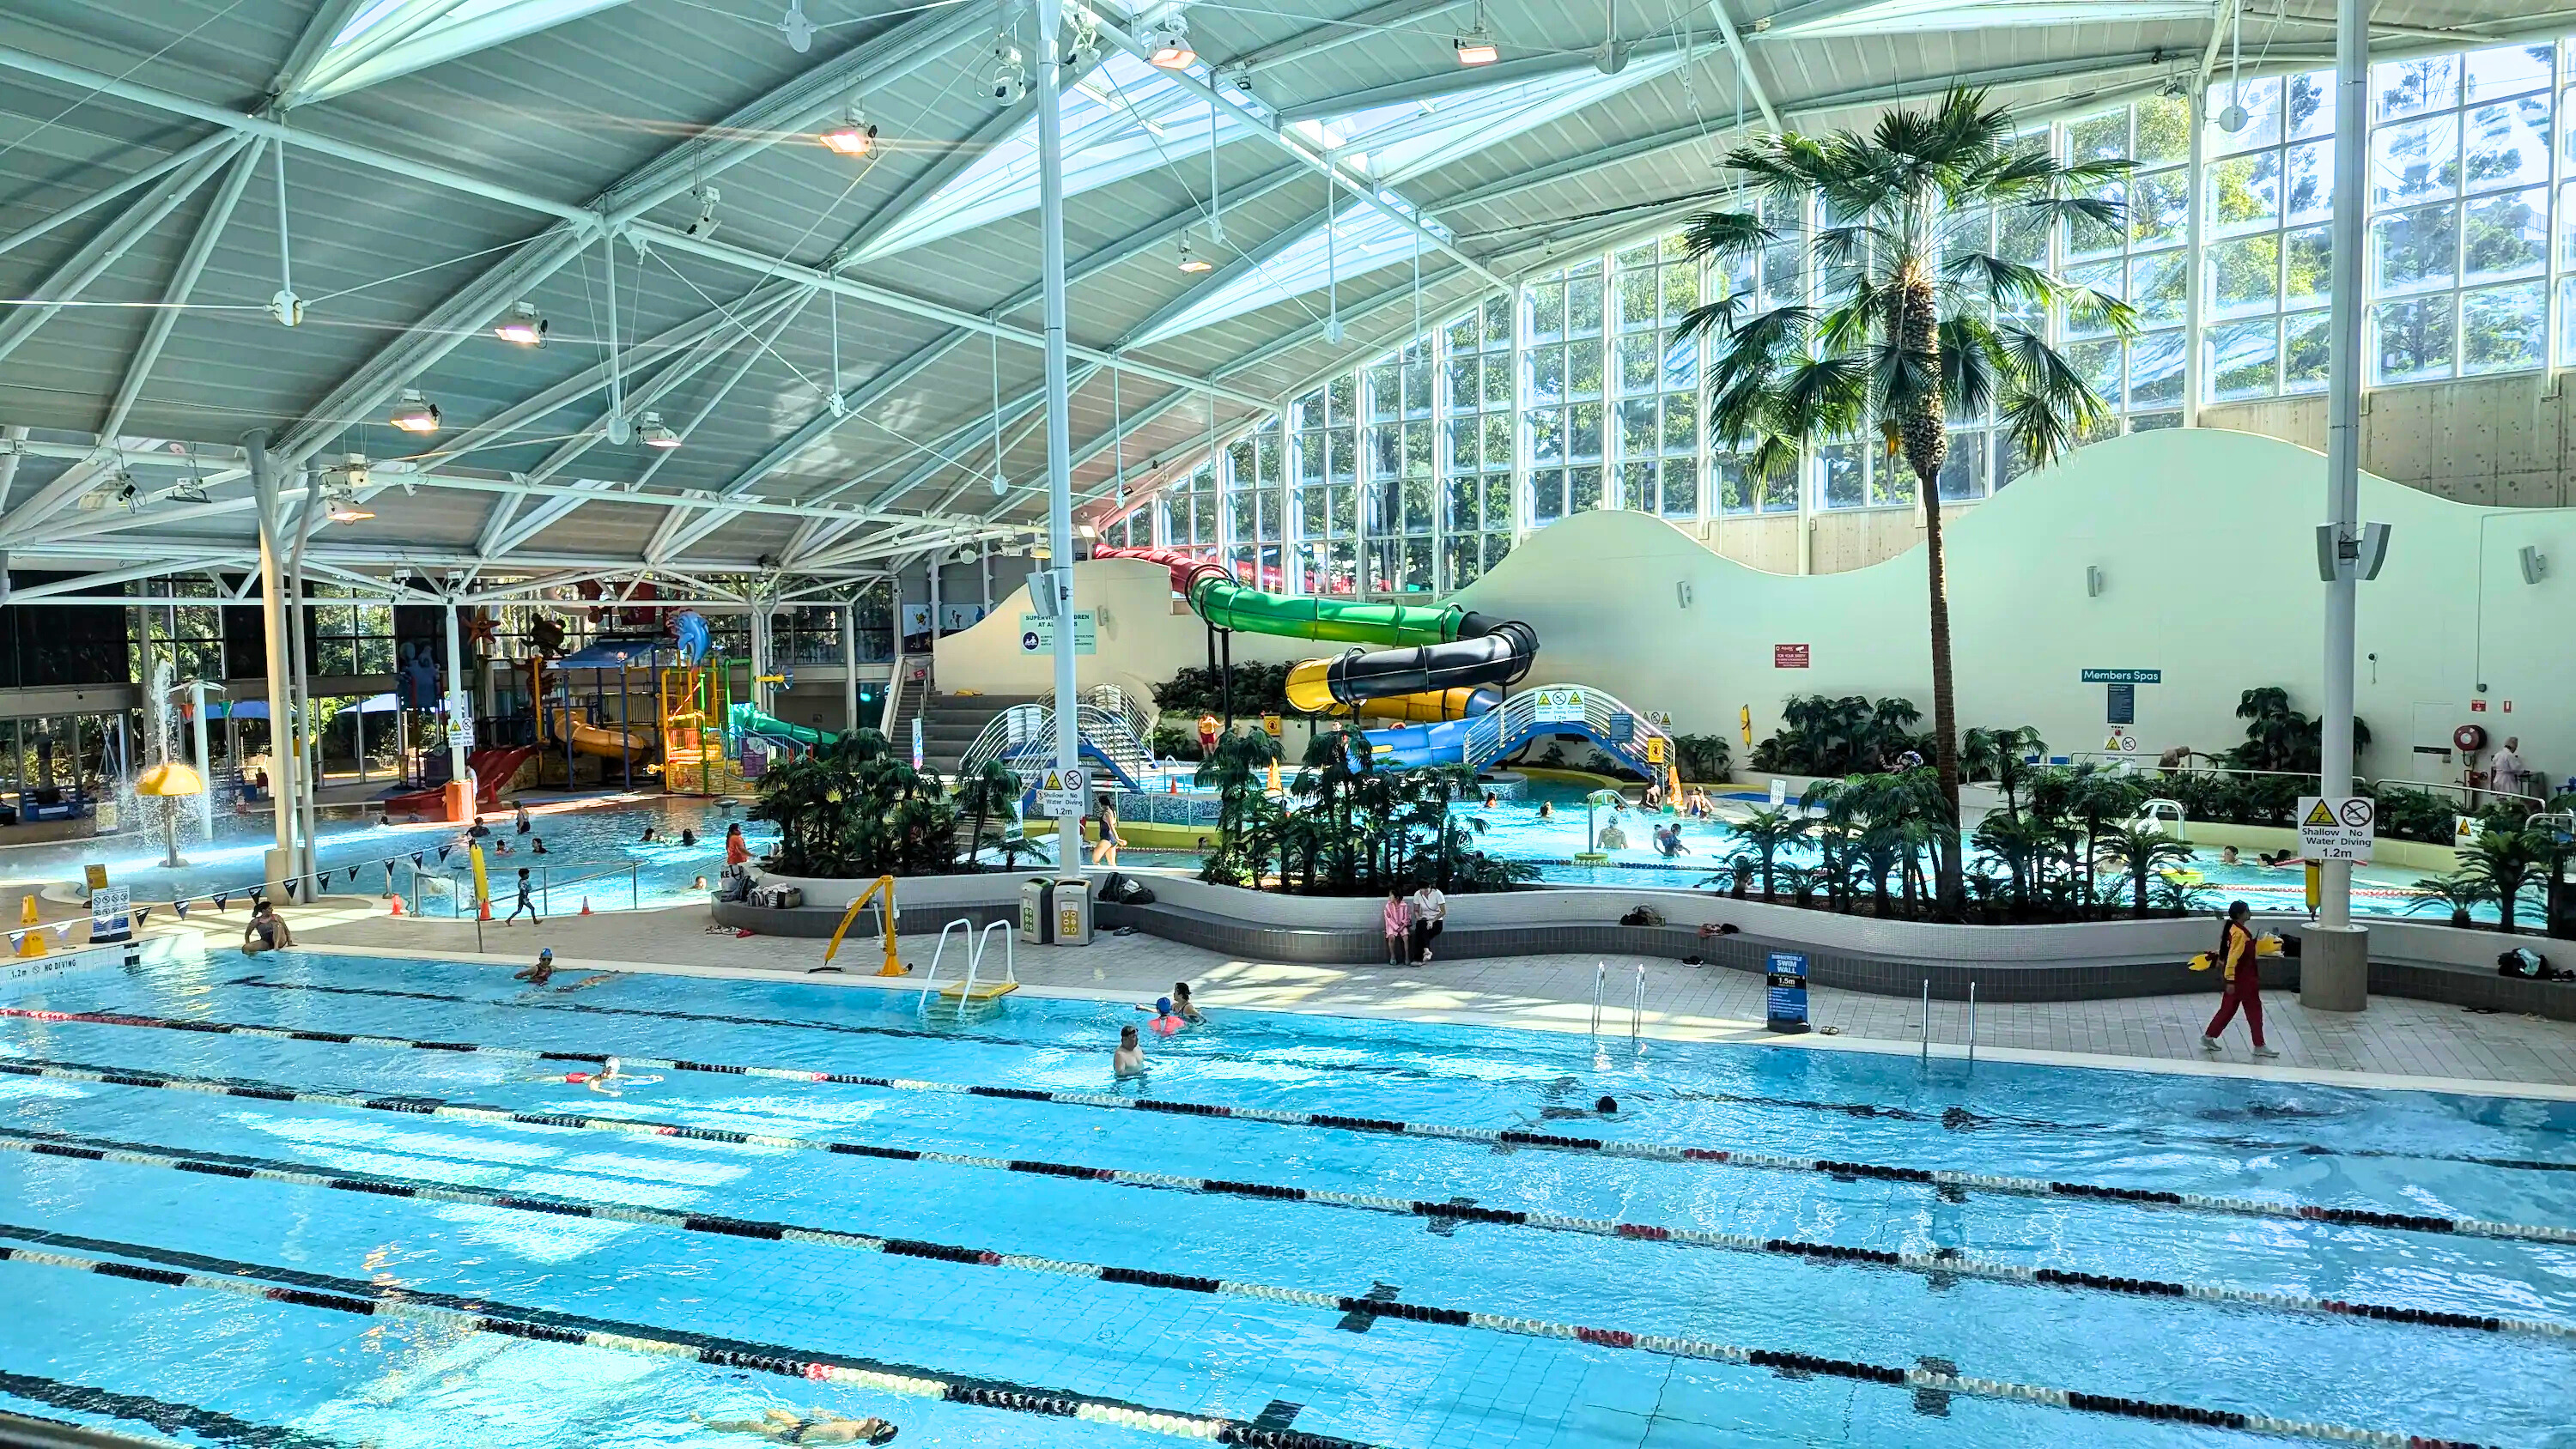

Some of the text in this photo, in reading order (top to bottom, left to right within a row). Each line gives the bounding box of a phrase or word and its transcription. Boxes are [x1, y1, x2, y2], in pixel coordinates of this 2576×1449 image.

[2083, 670, 2159, 682] Members Spas
[2302, 828, 2340, 836] Shallow
[2306, 837, 2336, 846] Water
[2340, 837, 2372, 848] Diving
[2322, 847, 2352, 858] 1.2m
[10, 968, 27, 979] 1.2m
[54, 959, 77, 970] DIVING
